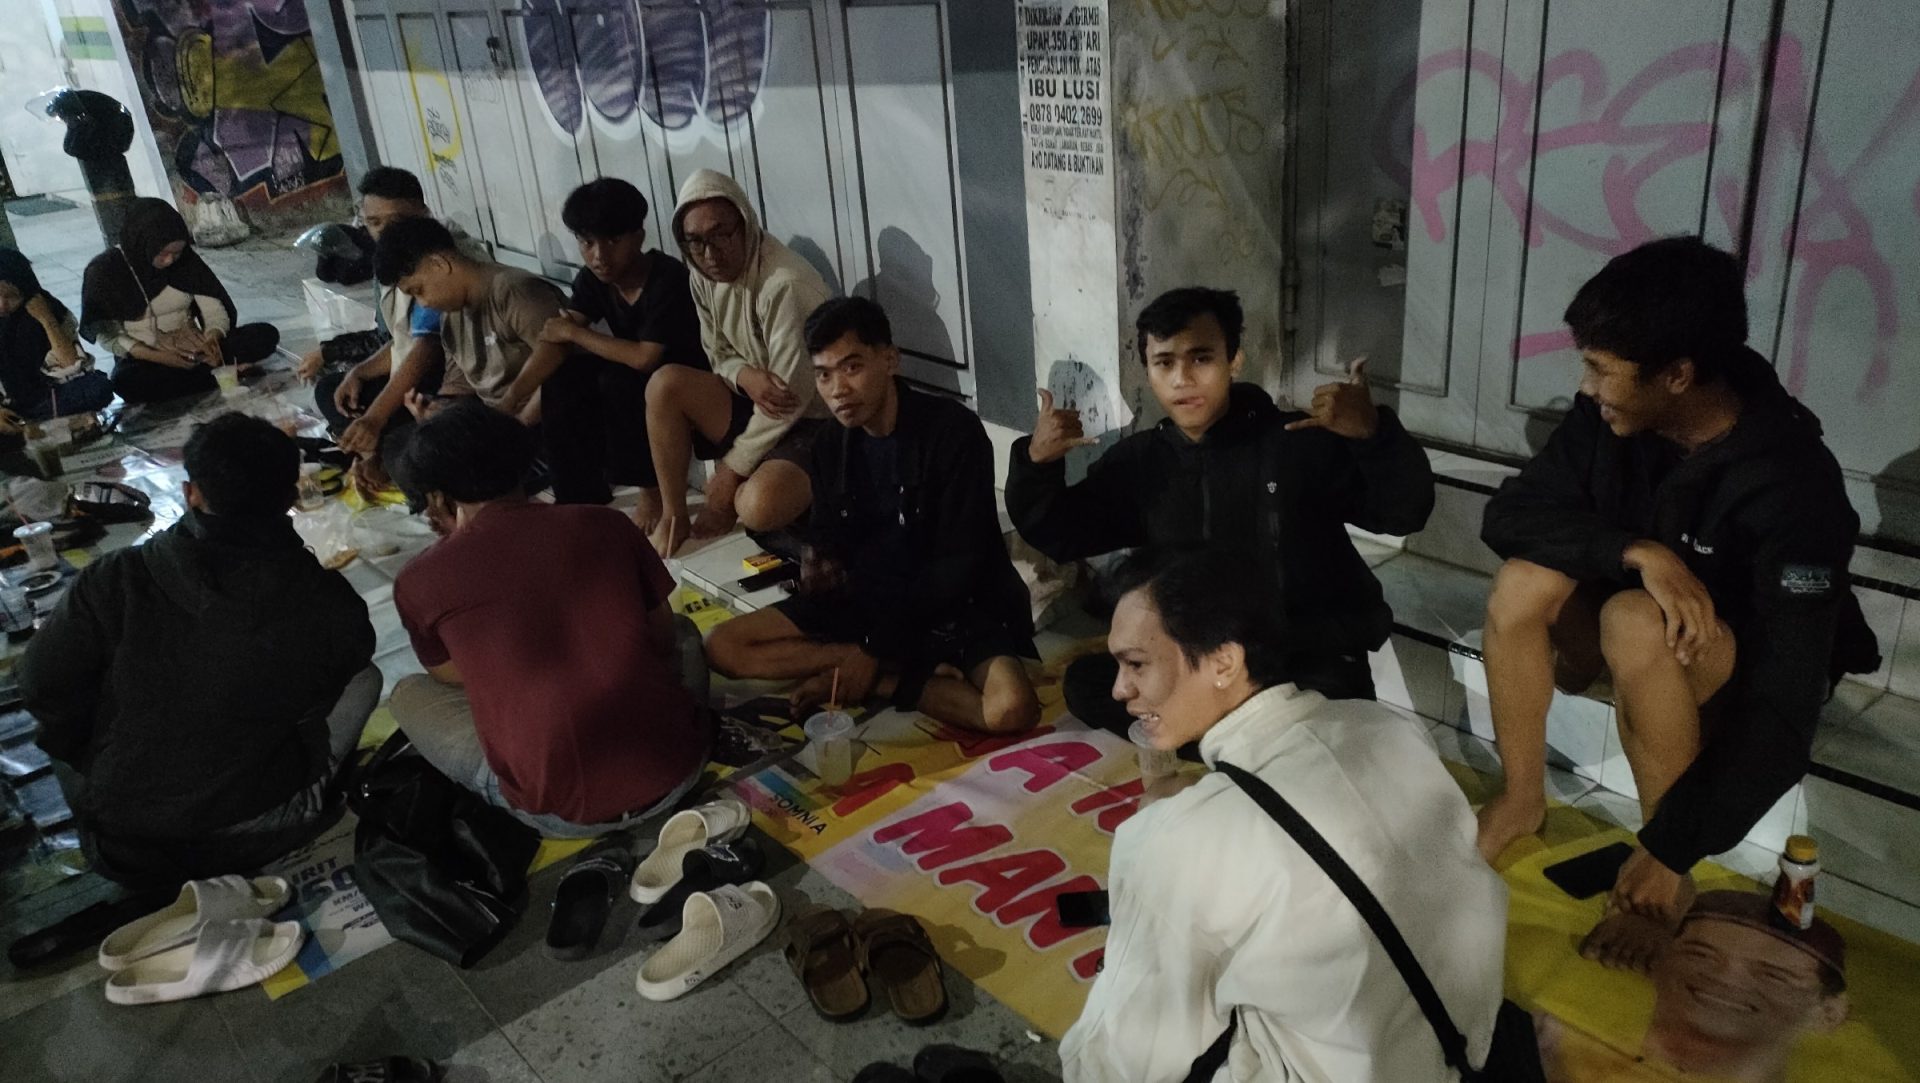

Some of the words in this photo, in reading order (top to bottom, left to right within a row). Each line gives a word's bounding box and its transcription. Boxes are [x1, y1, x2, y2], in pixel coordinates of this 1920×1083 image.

[1029, 78, 1056, 97] IBU
[1063, 79, 1100, 100] LUSI
[1030, 103, 1051, 122] 0878
[1081, 105, 1102, 126] 2699
[1044, 152, 1066, 171] DATANG
[769, 793, 828, 835] SOMNIA
